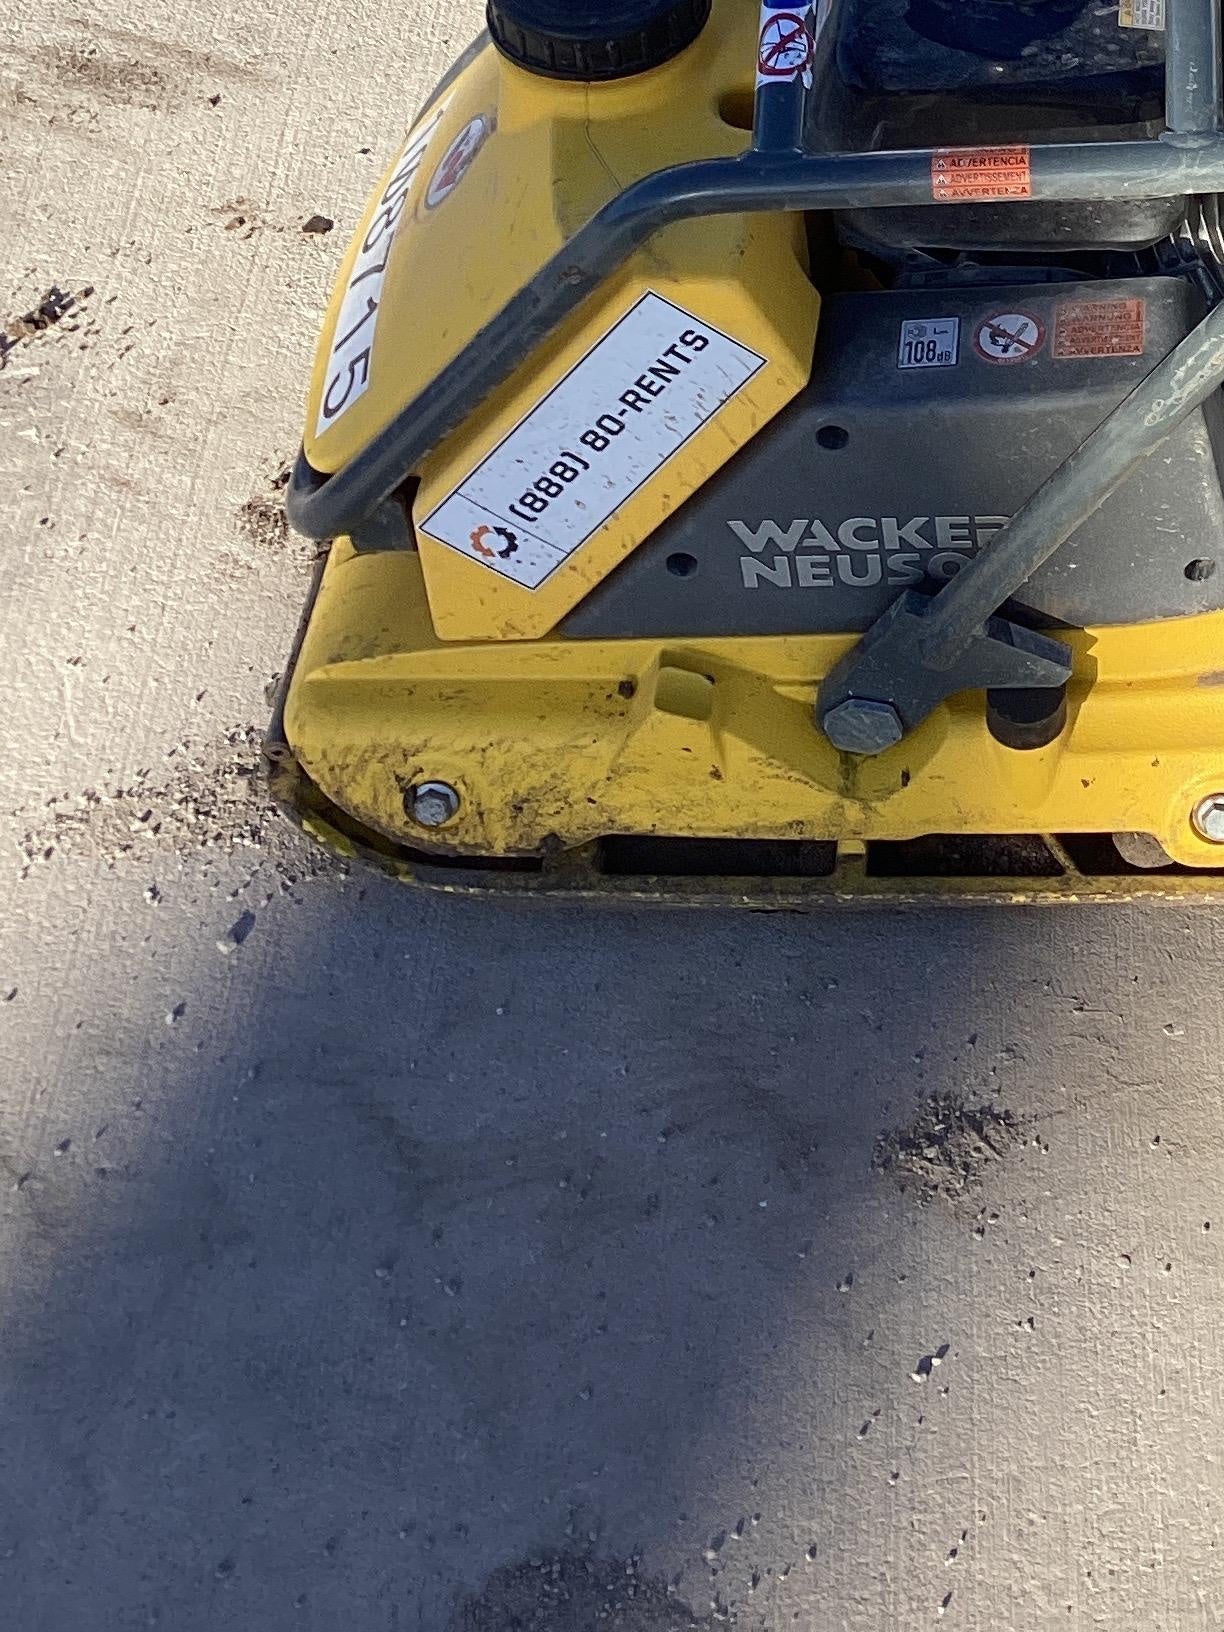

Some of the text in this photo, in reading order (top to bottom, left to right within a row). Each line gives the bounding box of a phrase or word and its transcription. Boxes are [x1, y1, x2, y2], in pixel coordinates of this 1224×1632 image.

[904, 339, 937, 364] 108
[508, 328, 710, 523] (888) 80-RENTS
[739, 551, 976, 589] NEUSO
